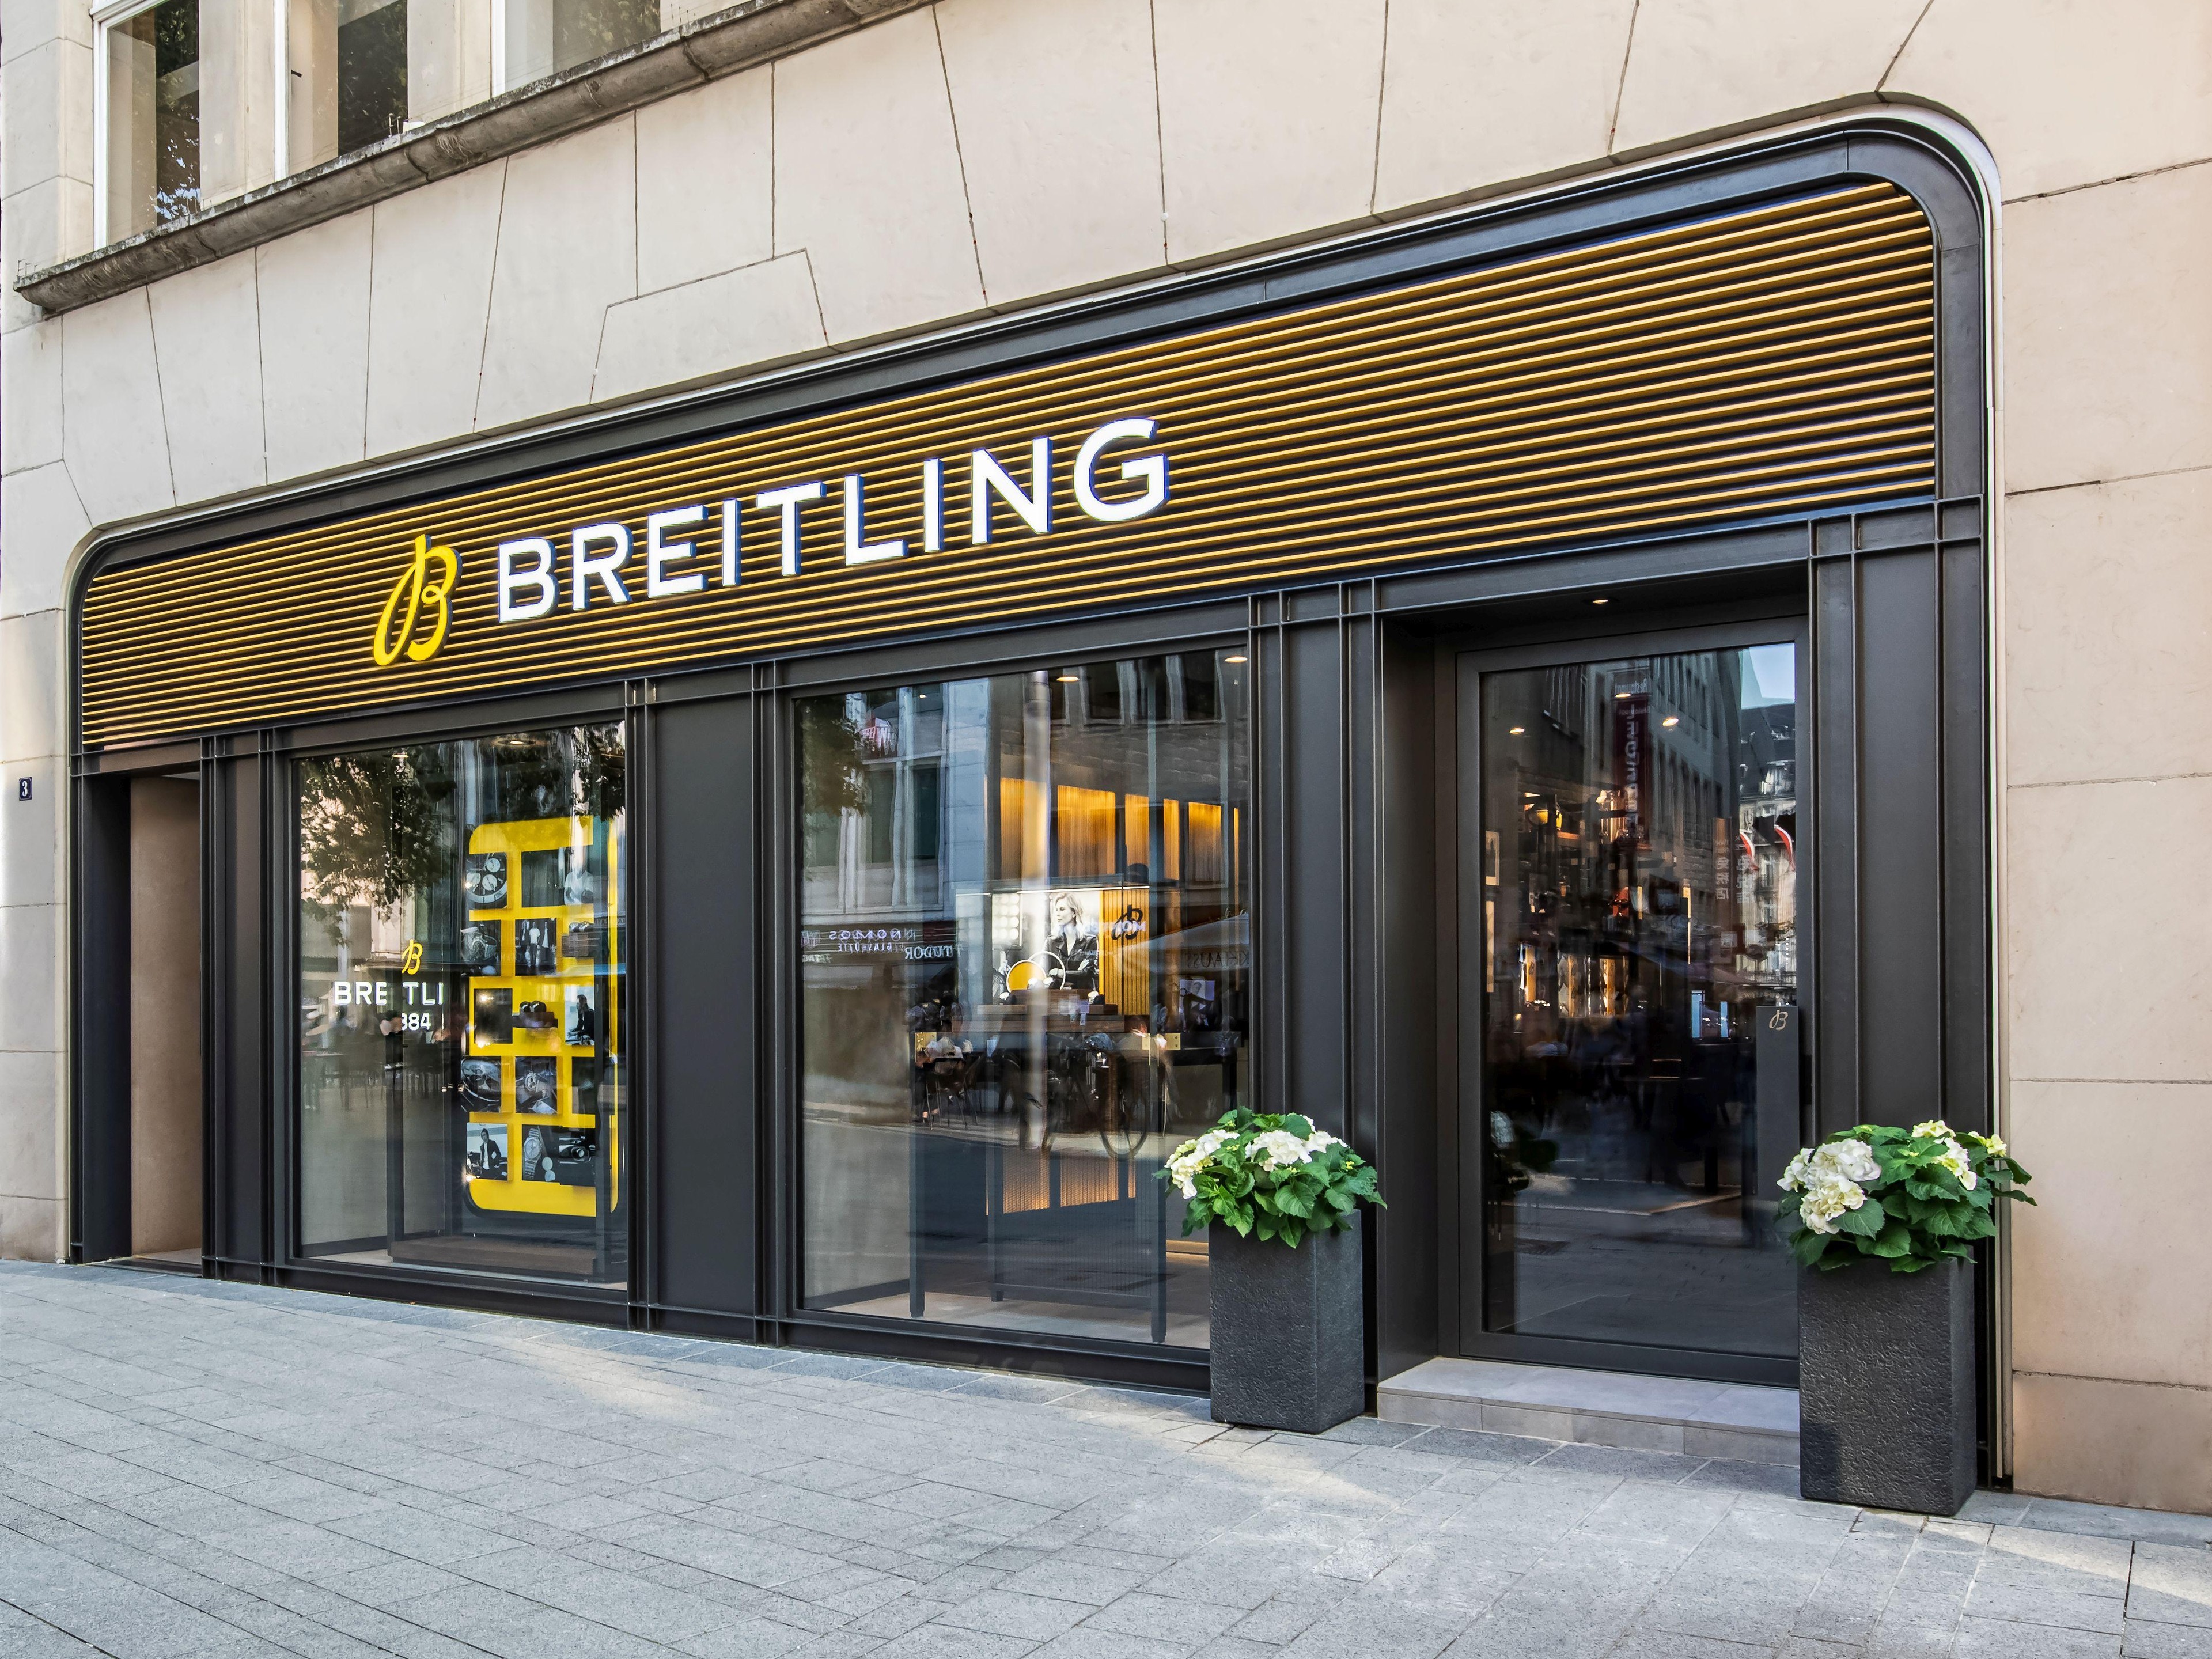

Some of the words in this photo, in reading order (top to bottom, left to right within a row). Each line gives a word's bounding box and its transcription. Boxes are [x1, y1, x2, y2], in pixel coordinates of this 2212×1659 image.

[497, 417, 1171, 624] BREITLING
[22, 780, 28, 797] 3
[334, 980, 444, 1005] BRETLI
[402, 1012, 431, 1031] 84
